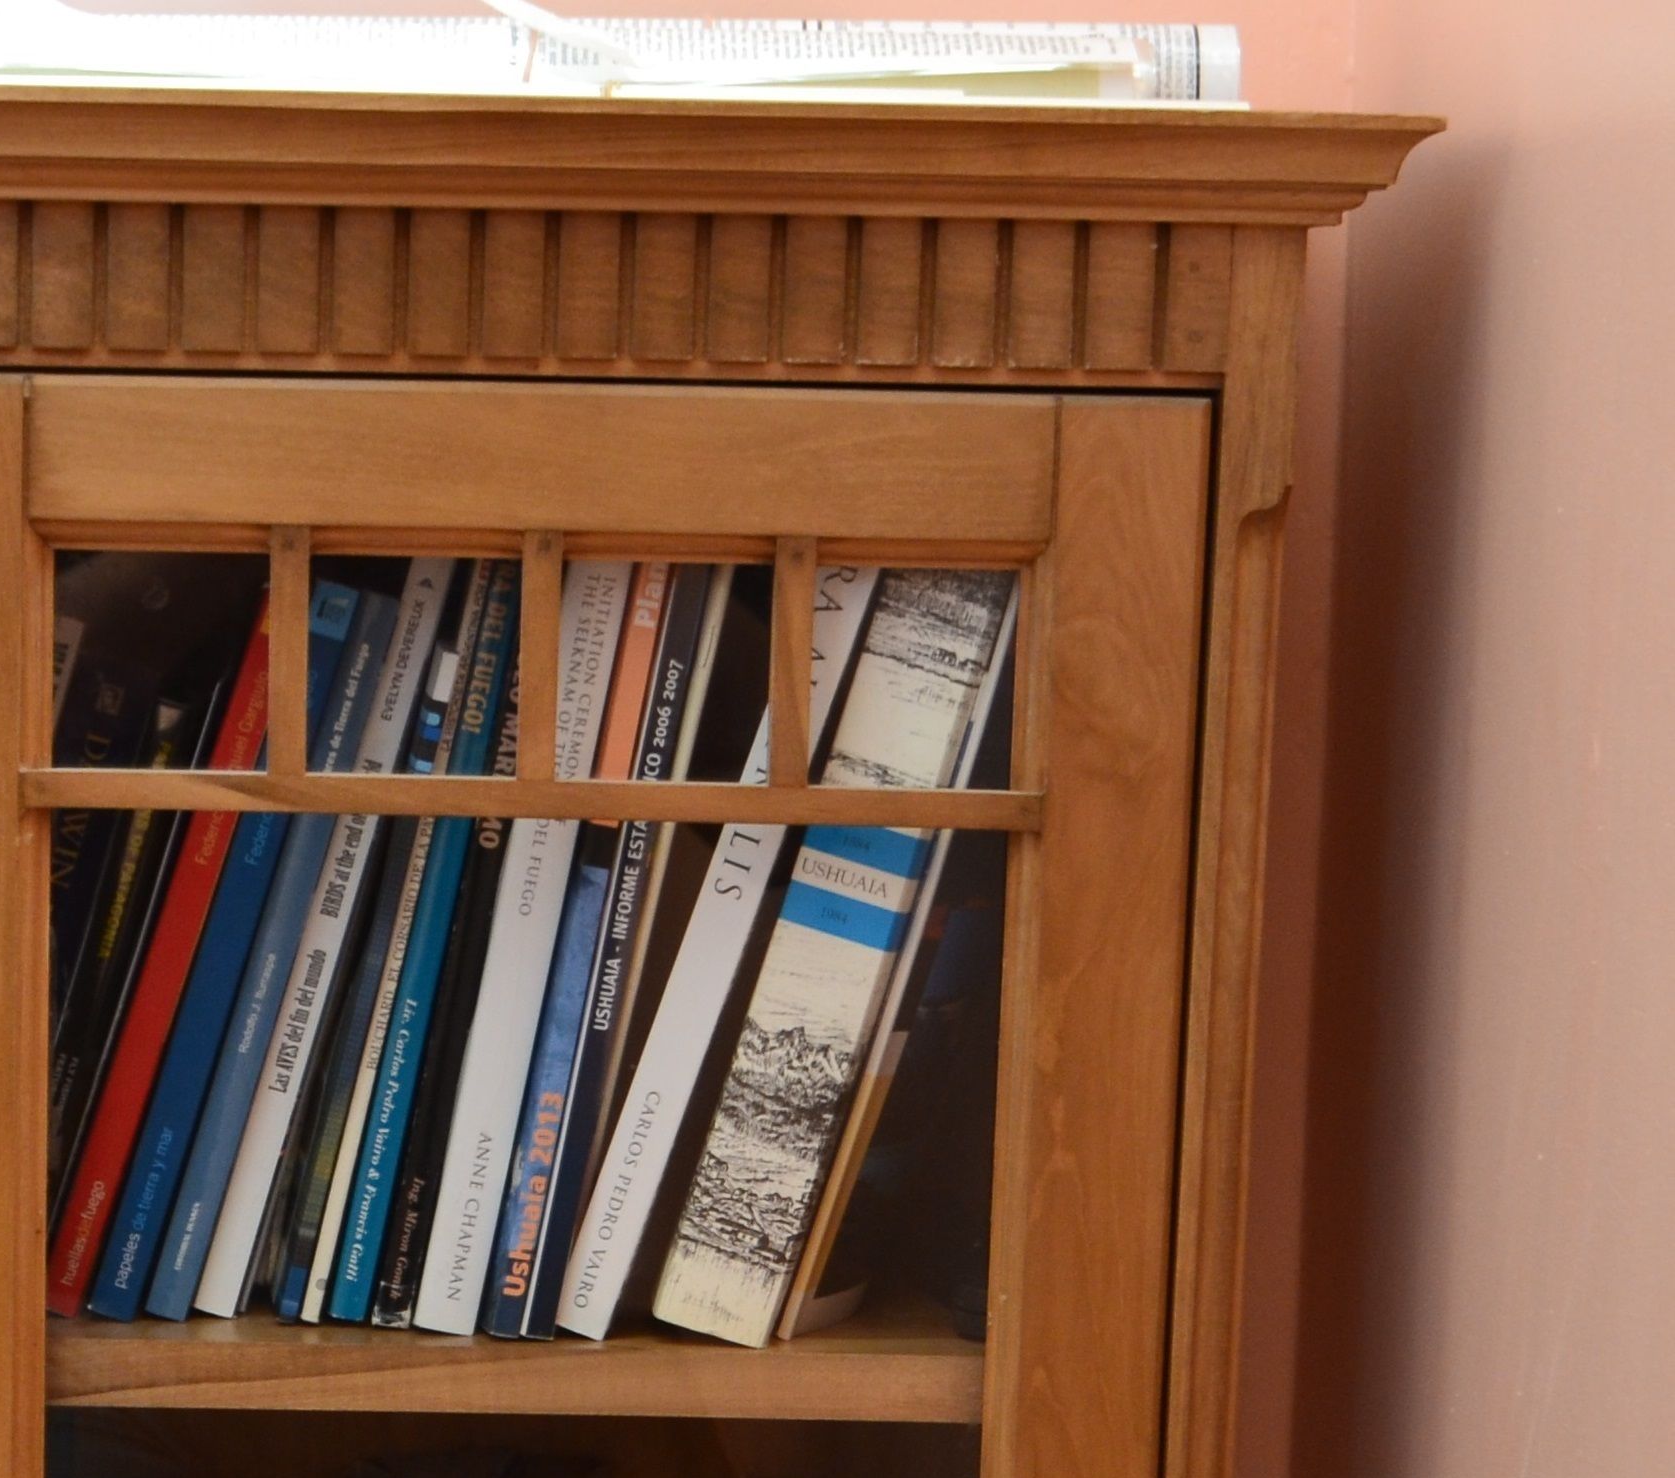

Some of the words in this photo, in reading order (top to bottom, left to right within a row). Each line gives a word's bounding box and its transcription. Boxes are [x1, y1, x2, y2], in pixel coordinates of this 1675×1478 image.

[580, 570, 601, 608] THE
[480, 601, 506, 644] DEL
[581, 575, 616, 686] INITIATION
[350, 641, 372, 678] Fuego
[378, 671, 405, 722] EVELYN
[393, 598, 426, 670] DEVEREUX
[561, 614, 592, 704] SELKNAM
[460, 651, 496, 733] FUEGO!
[45, 728, 111, 889] DWIN
[243, 810, 273, 867] Federic
[333, 847, 356, 870] the
[339, 825, 362, 848] end
[591, 955, 622, 1031] USHUAIA
[610, 863, 640, 940] INFORME
[648, 704, 671, 747] 2006
[660, 658, 684, 700] 2007
[318, 880, 346, 919] BIRDS
[517, 854, 542, 917] FUEGO
[801, 857, 887, 898] USHUAIA
[390, 887, 419, 961] CORSARIO
[299, 946, 327, 989] mundo
[293, 986, 315, 1008] del
[399, 997, 419, 1026] Lic.
[237, 1012, 259, 1054] Rodolfo
[282, 1022, 304, 1043] del
[387, 1027, 412, 1077] Carlos
[274, 1042, 298, 1072] AVES
[267, 1070, 291, 1094] Las
[377, 1079, 400, 1124] Pedro
[154, 1126, 175, 1156] mar
[369, 1125, 389, 1165] Vairo
[621, 1087, 662, 1170] CARLOS
[467, 1131, 494, 1190] ANNE
[136, 1170, 160, 1210] tierra
[352, 1183, 377, 1239] Francis
[499, 1171, 547, 1299] Ushuaia
[528, 1087, 565, 1167] 2013
[596, 1172, 632, 1242] PEDRO
[129, 1211, 147, 1231] de
[398, 1208, 418, 1253] Miron
[110, 1230, 144, 1290] papeles
[444, 1197, 480, 1302] CHAPMAN
[571, 1245, 607, 1310] VAIRO
